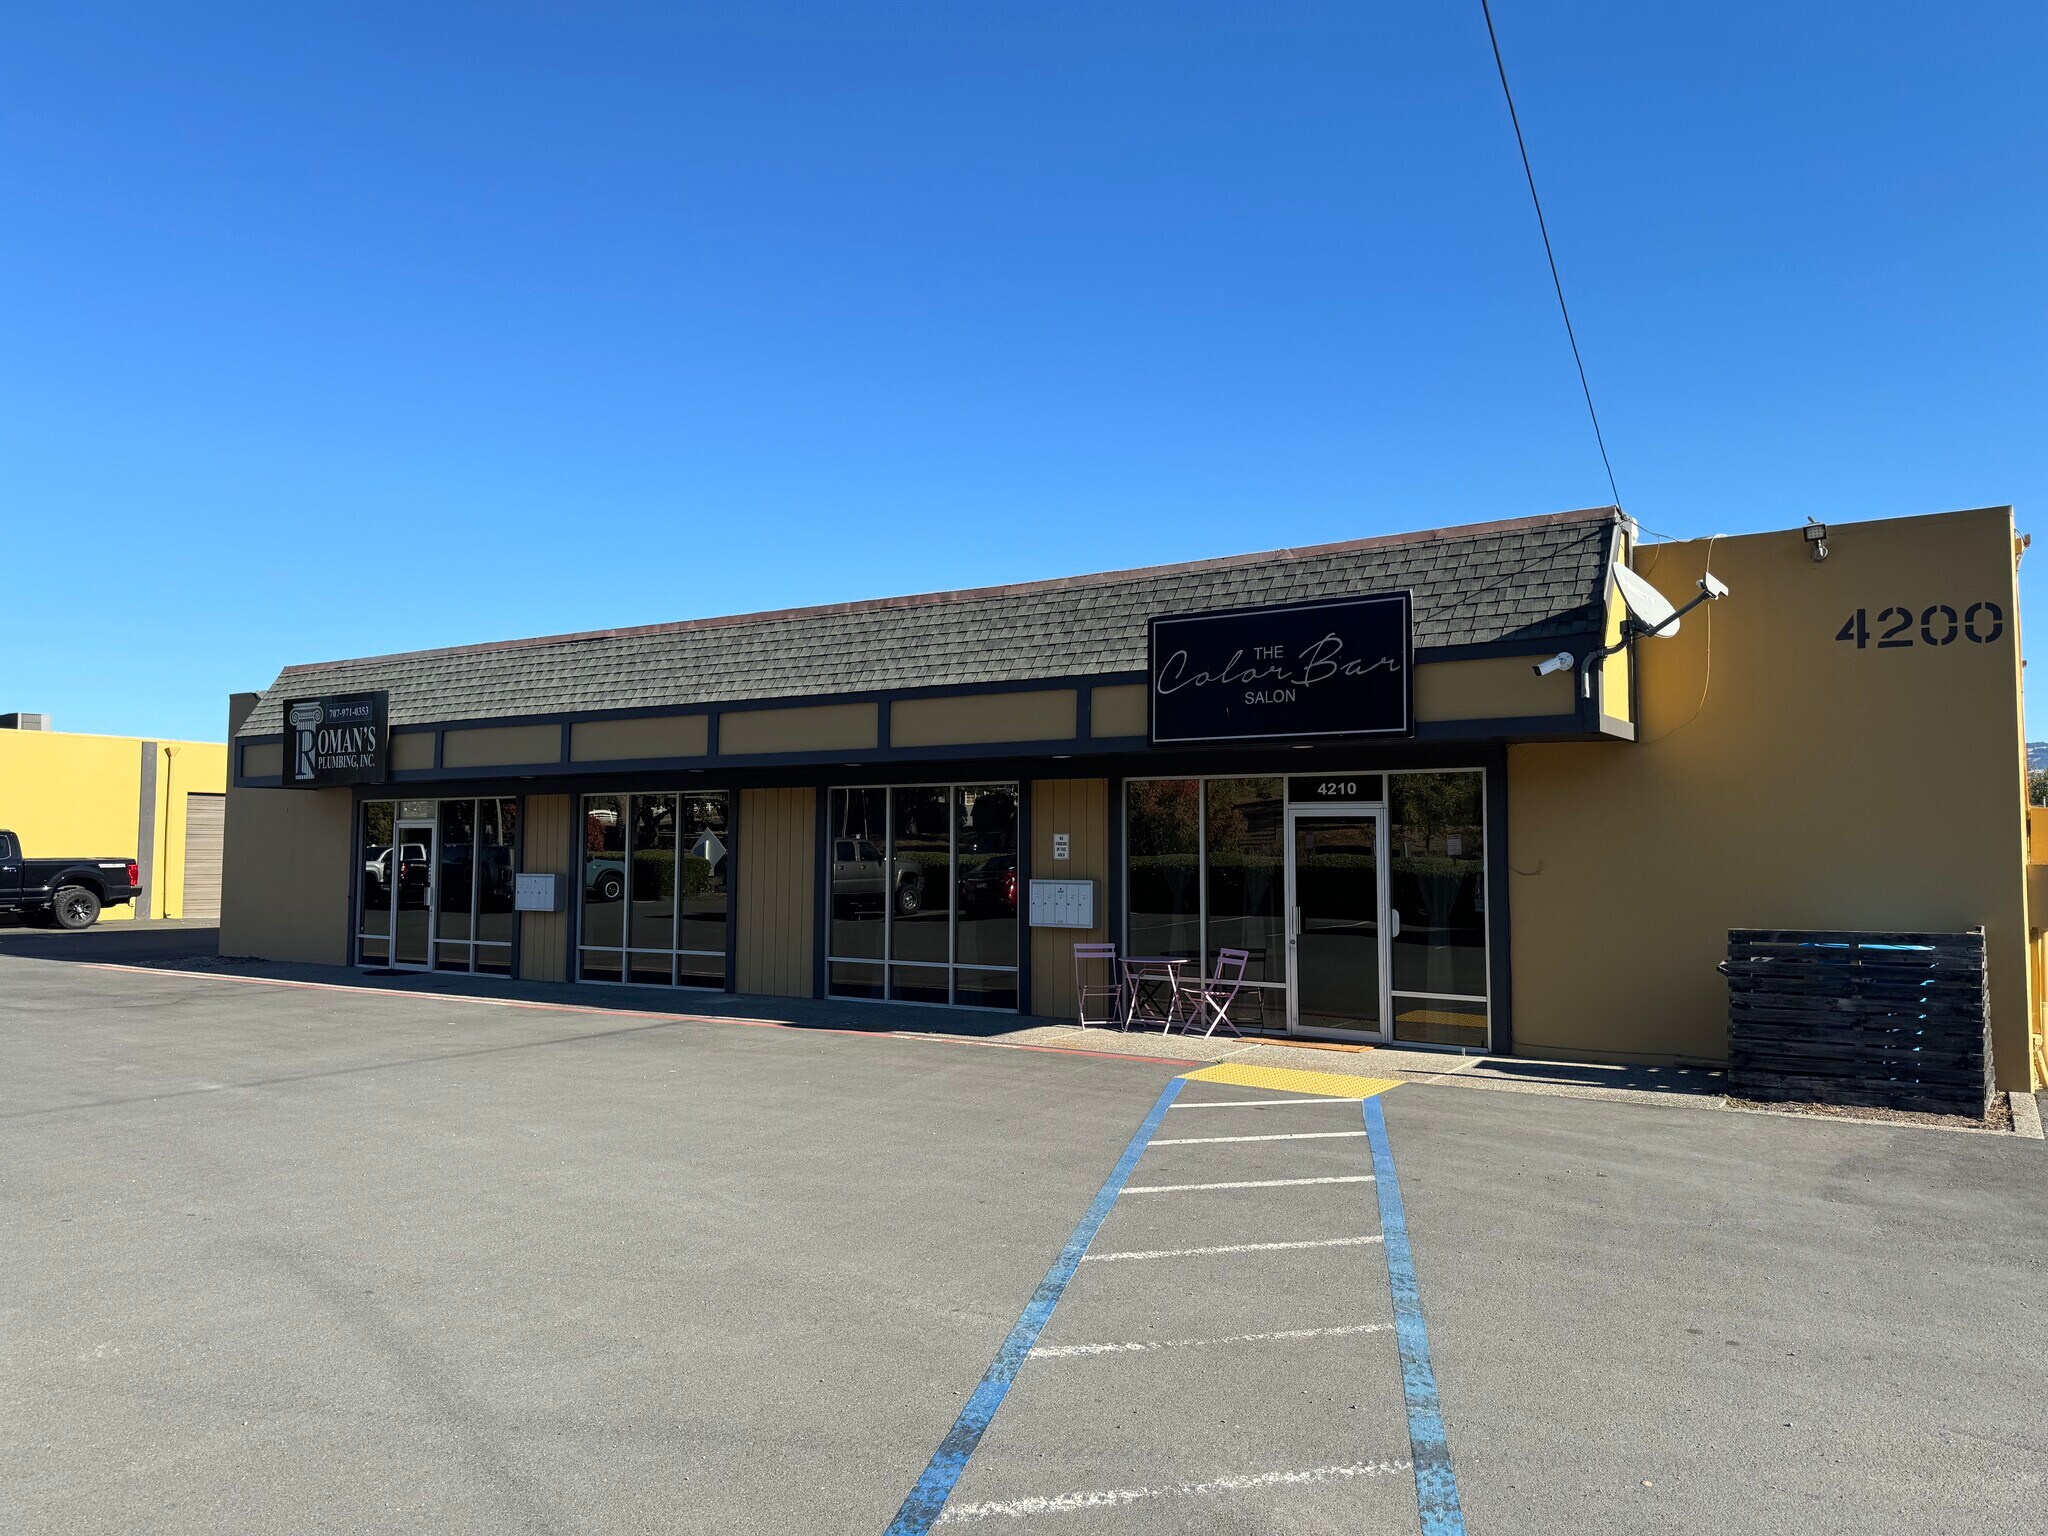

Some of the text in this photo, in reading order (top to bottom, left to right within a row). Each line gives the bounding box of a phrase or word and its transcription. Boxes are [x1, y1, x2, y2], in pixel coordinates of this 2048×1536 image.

[1835, 602, 2003, 649] 4200
[1253, 645, 1284, 660] THE
[1157, 632, 1401, 695] Color Bar
[1244, 689, 1296, 705] SALON
[329, 706, 369, 718] 707-971-0353
[318, 753, 375, 770] PLUMBING, INC.
[1317, 782, 1357, 795] 4210
